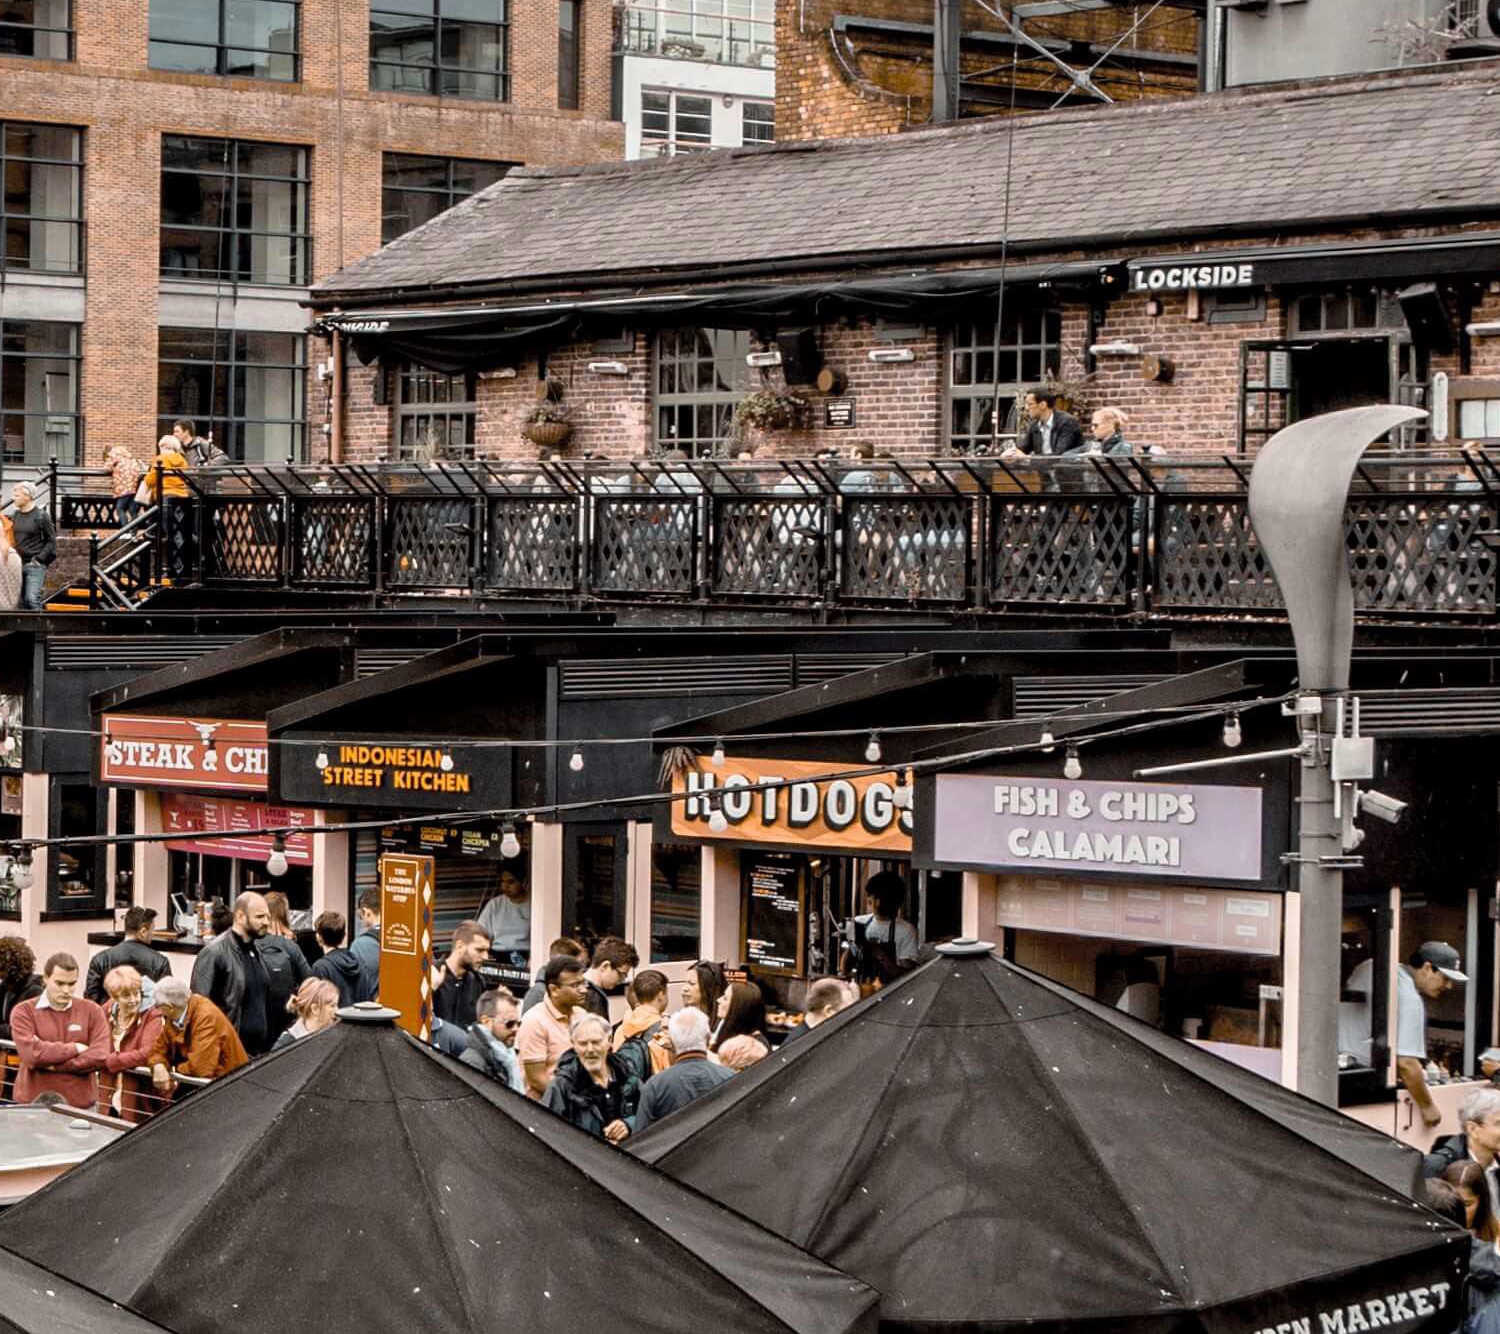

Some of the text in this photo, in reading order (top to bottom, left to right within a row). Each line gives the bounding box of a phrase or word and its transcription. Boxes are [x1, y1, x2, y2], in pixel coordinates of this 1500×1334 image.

[1135, 264, 1253, 290] LOCKSIDE
[110, 741, 195, 771] STEAK
[323, 767, 470, 793] STREET KITCHEN
[994, 785, 1197, 825] FISH & CHIPS
[1007, 828, 1182, 867] CALAMARI
